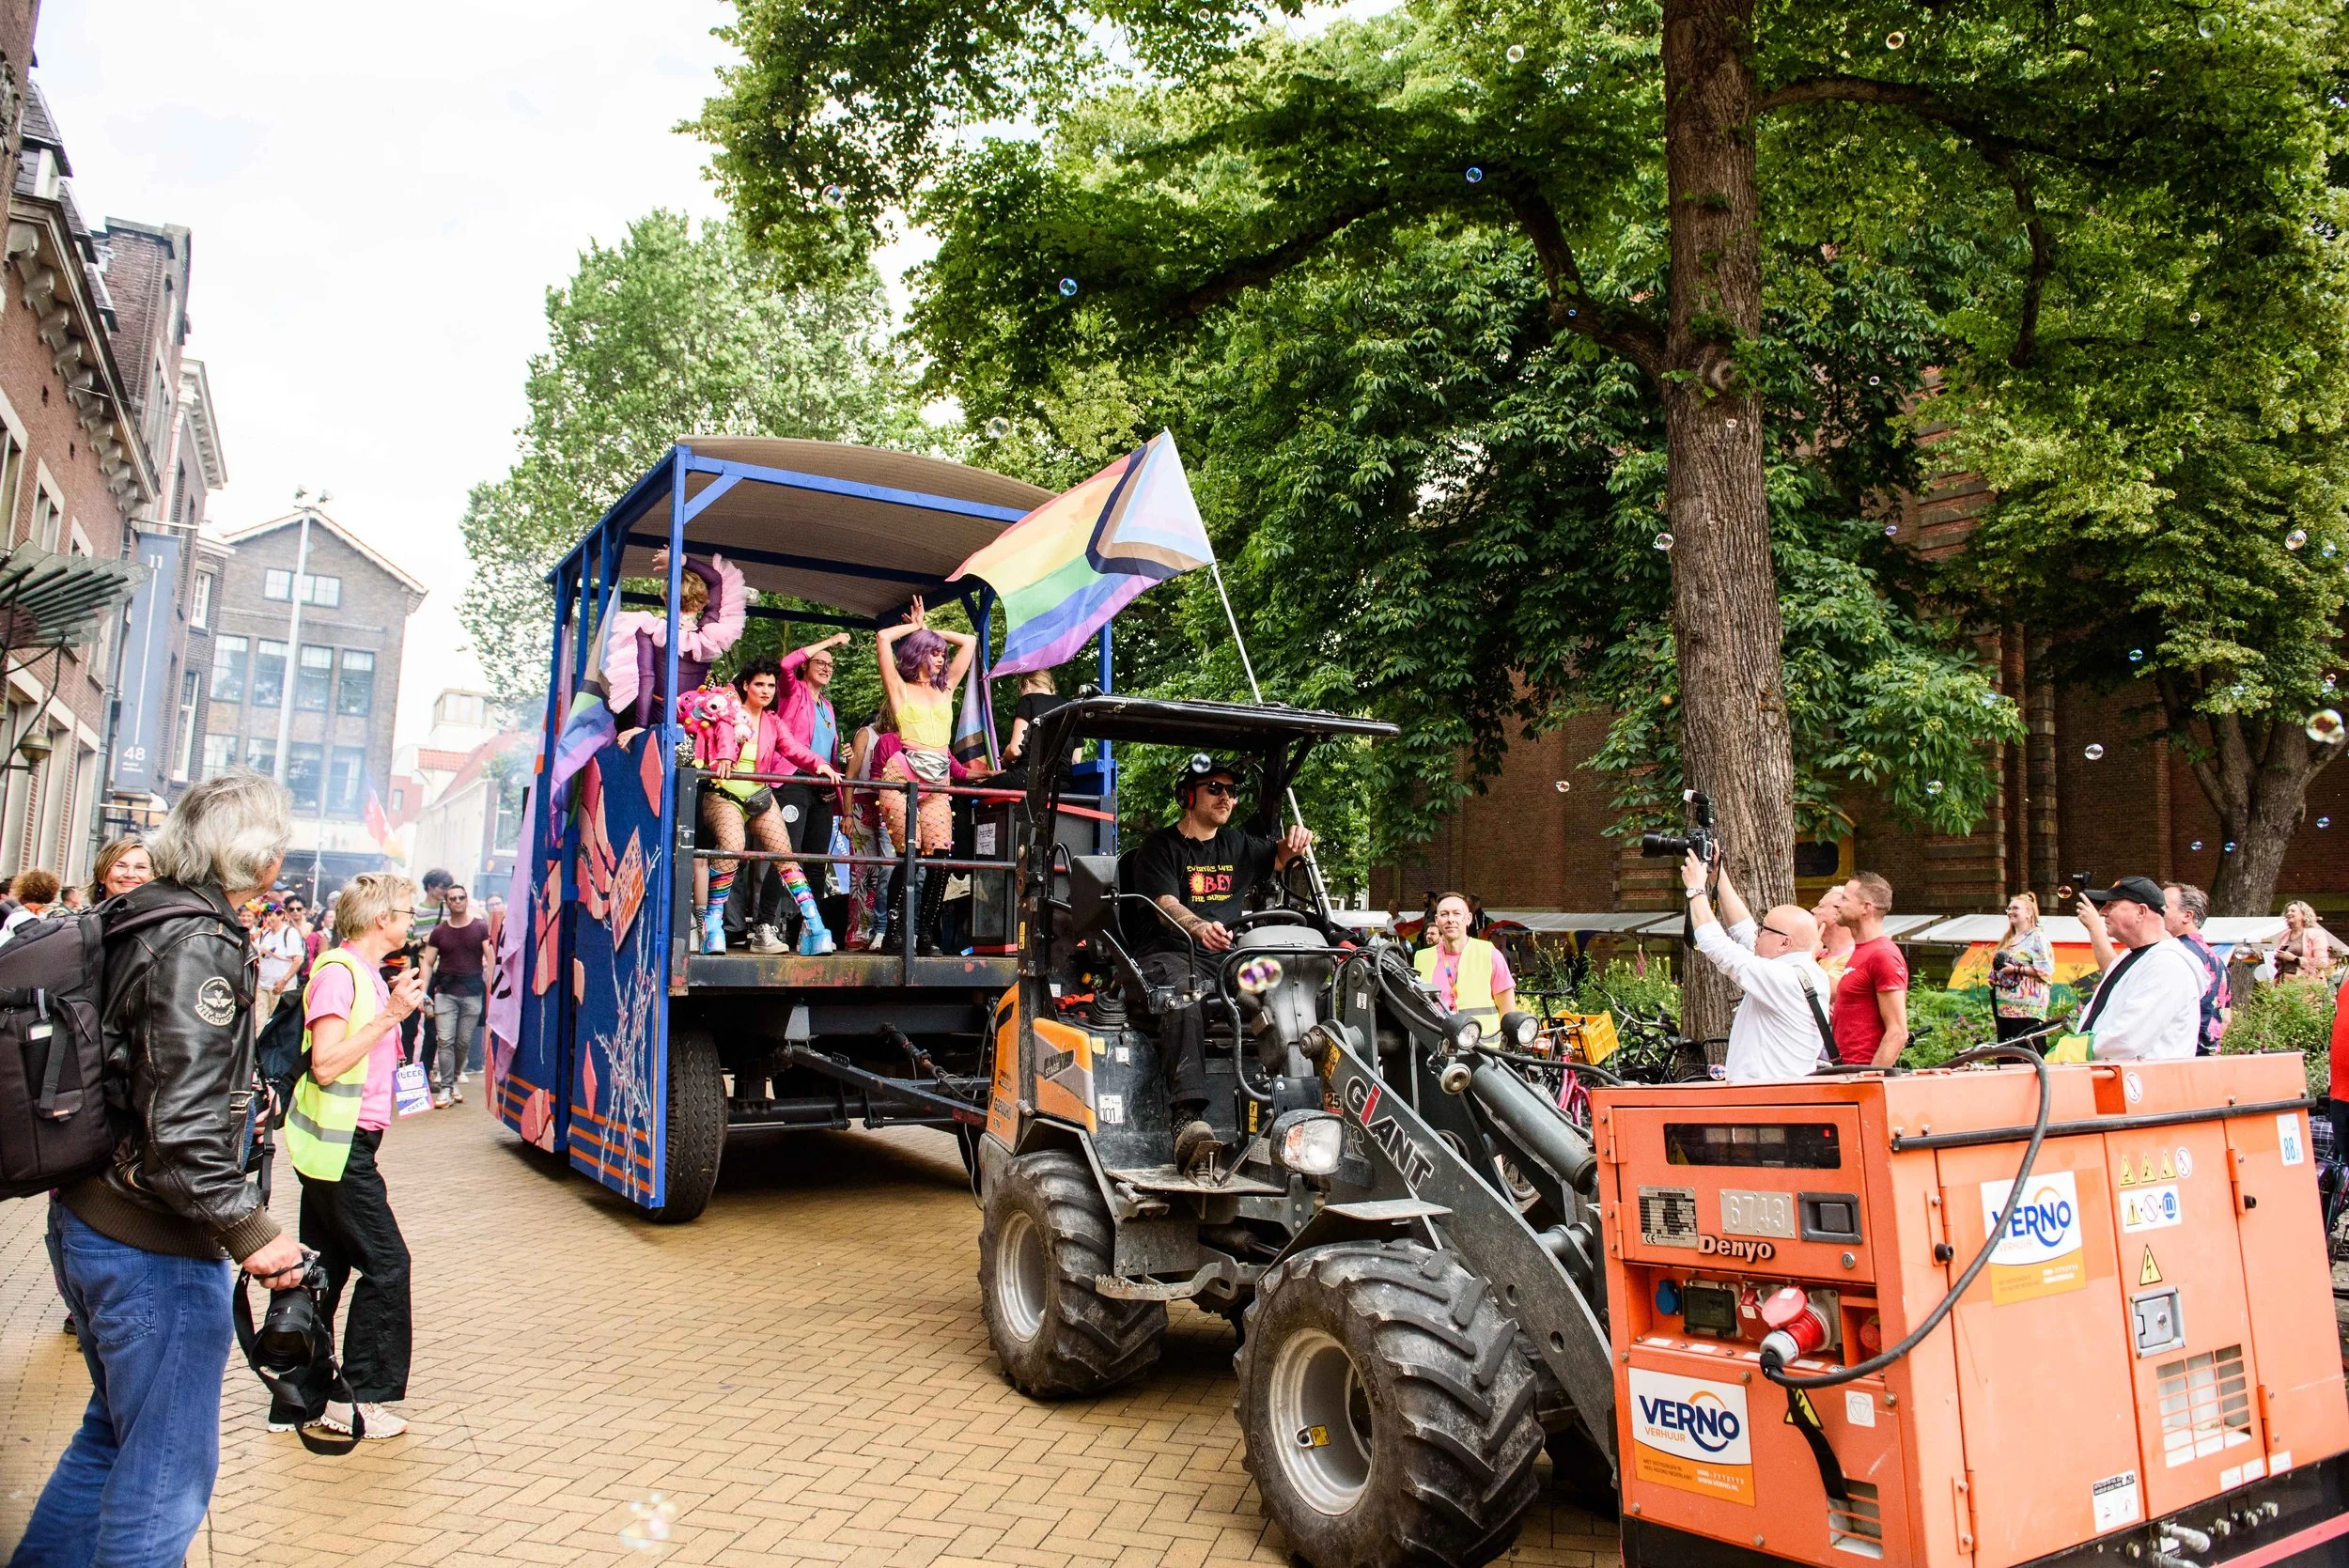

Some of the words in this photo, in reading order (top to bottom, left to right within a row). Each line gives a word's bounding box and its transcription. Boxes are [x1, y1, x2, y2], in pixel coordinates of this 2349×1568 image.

[148, 554, 163, 569] 11
[123, 747, 146, 762] 48
[1101, 1107, 1116, 1122] 101
[2283, 1137, 2295, 1161] 88
[1730, 1195, 1785, 1231] 6743
[1698, 1234, 1775, 1263] Denyo
[1638, 1394, 1740, 1452] VERNO
[1644, 1426, 1686, 1443] VERHUUR
